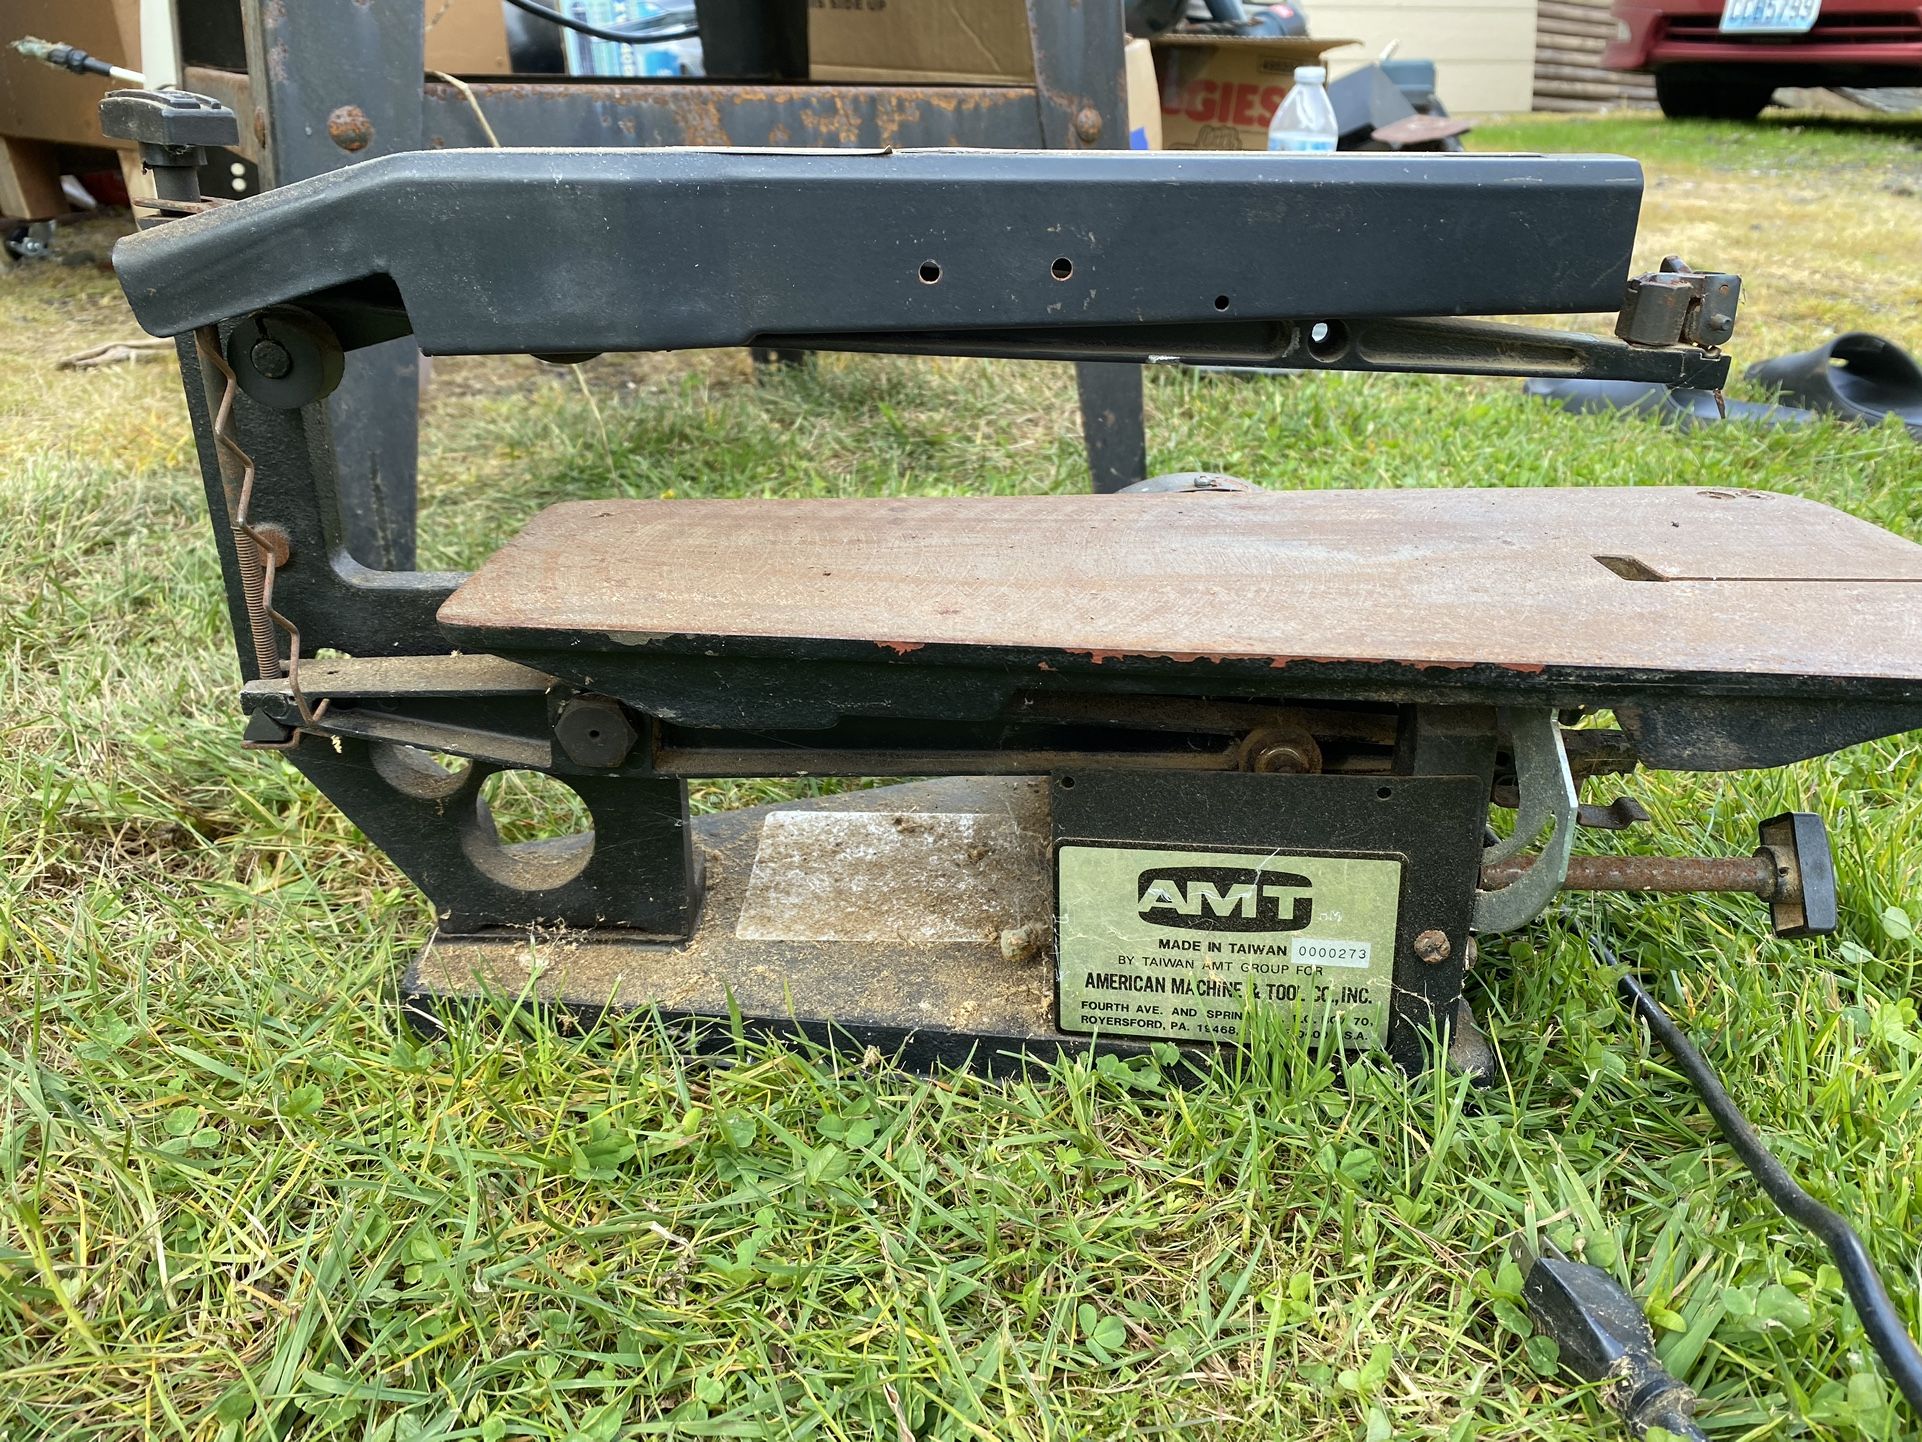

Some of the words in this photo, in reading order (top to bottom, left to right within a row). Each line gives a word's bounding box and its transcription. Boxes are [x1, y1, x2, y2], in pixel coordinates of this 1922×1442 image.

[1138, 878, 1313, 920] AMT
[1158, 938, 1201, 952] MADE
[1207, 941, 1222, 953] IN
[1228, 943, 1287, 956] TAIWAN
[1298, 945, 1367, 960] 0000273
[1118, 955, 1135, 965] BY
[1142, 956, 1195, 969] TAIWAN
[1201, 961, 1233, 971] AMT
[1240, 962, 1289, 975] GROUP
[1296, 965, 1324, 977] FOR
[1085, 971, 1166, 993] AMERICAN
[1171, 977, 1243, 999] MACHINE
[1081, 1000, 1129, 1013] FOURTH
[1136, 1005, 1163, 1015] AVE.
[1171, 1008, 1197, 1017] AND
[1206, 1010, 1243, 1021] SPRIN
[1353, 1017, 1374, 1027] 70,
[1081, 1015, 1166, 1031] ROYERSFORD,
[1170, 1022, 1190, 1031] PA.
